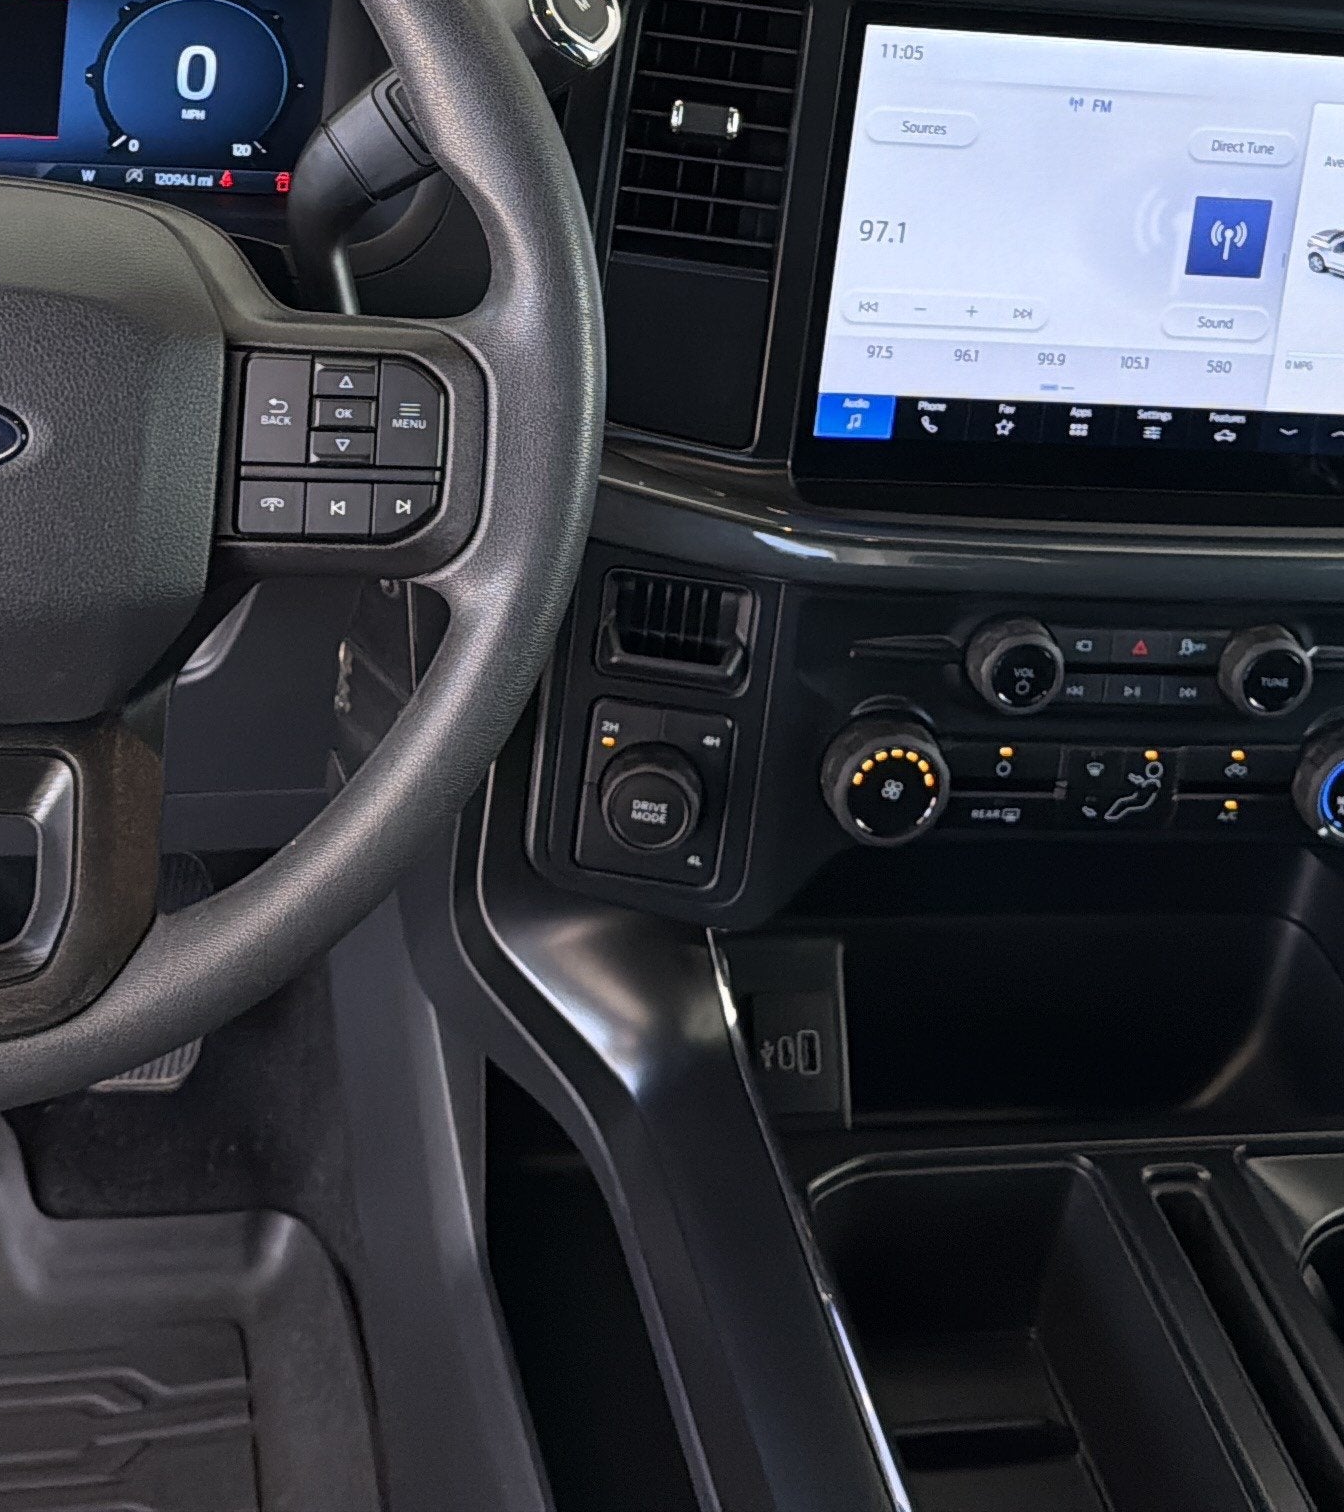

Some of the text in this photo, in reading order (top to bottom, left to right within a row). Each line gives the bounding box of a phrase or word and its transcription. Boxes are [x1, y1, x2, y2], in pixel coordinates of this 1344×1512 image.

[879, 43, 924, 61] 11:05
[176, 45, 217, 101] 0
[1091, 98, 1113, 114] FM
[181, 108, 206, 120] MPH
[900, 120, 947, 136] Sources
[128, 139, 140, 153] 0
[1210, 139, 1274, 156] Direct Tune
[81, 169, 96, 182] W
[197, 174, 214, 187] mi
[859, 219, 907, 244] 97.1
[1196, 316, 1234, 330] Sound
[866, 344, 1233, 374] 97.5 96.1 99.9 105.1 580
[335, 408, 353, 419] OK
[842, 397, 871, 409] Audio
[917, 399, 947, 412] Phone
[1069, 406, 1093, 419] Apps
[1136, 408, 1173, 423] Settings
[1209, 412, 1247, 425] Features
[260, 414, 292, 427] BACK
[392, 418, 427, 430] MENU
[1013, 667, 1034, 679] VOL
[1261, 676, 1289, 688] TUNE
[601, 720, 619, 733] 2H
[702, 735, 721, 748] 4H
[632, 799, 668, 814] DRIVE
[631, 810, 667, 824] MODE
[971, 809, 1000, 819] REAR
[687, 855, 702, 867] 4L
